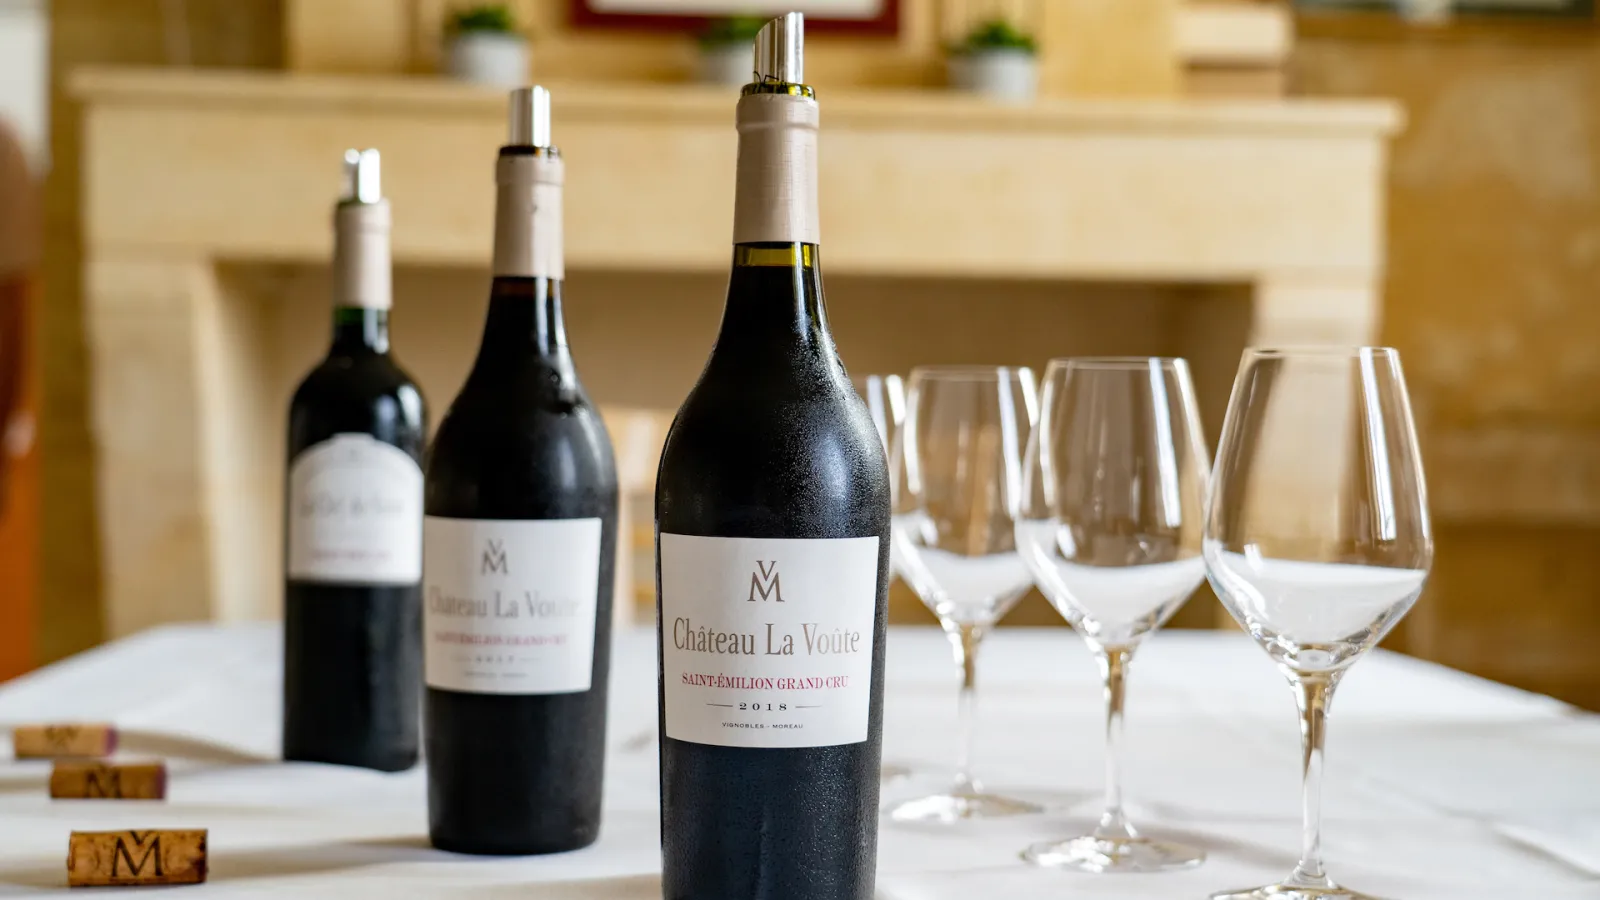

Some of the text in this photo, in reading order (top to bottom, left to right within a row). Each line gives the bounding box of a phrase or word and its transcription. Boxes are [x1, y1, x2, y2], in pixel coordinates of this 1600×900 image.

[494, 589, 519, 617] La
[673, 616, 861, 655] Château La Voûte
[681, 672, 849, 690] SAINT-ÉMILION GRAND CRU
[739, 702, 787, 711] 2018
